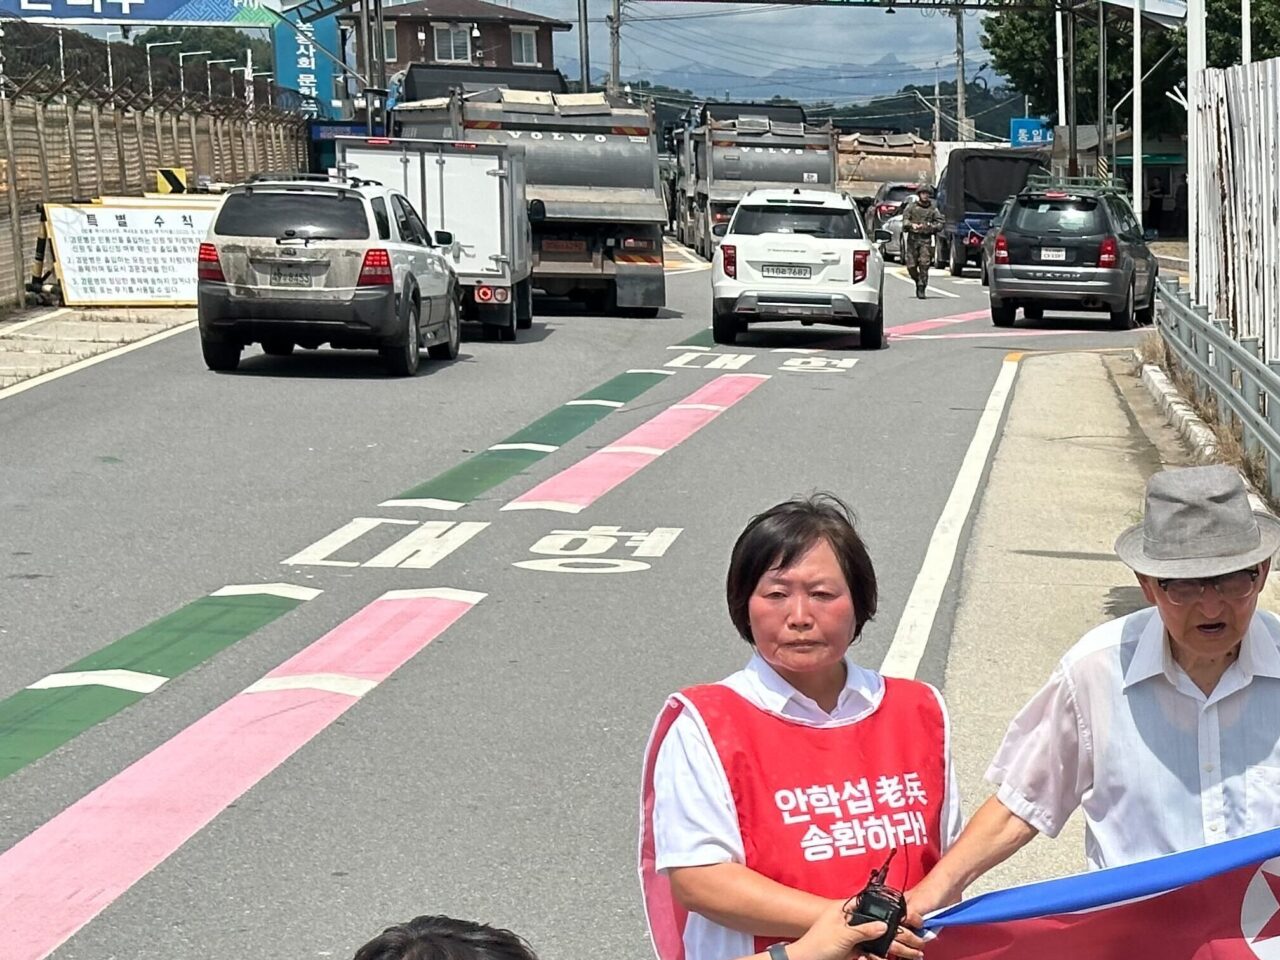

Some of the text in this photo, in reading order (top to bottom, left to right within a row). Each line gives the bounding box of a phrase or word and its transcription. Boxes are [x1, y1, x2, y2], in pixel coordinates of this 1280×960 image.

[508, 131, 607, 143] VOLVO
[280, 516, 685, 573] 대형
[774, 771, 929, 825] 안학섭 老兵
[800, 810, 929, 862] 송환하라!
